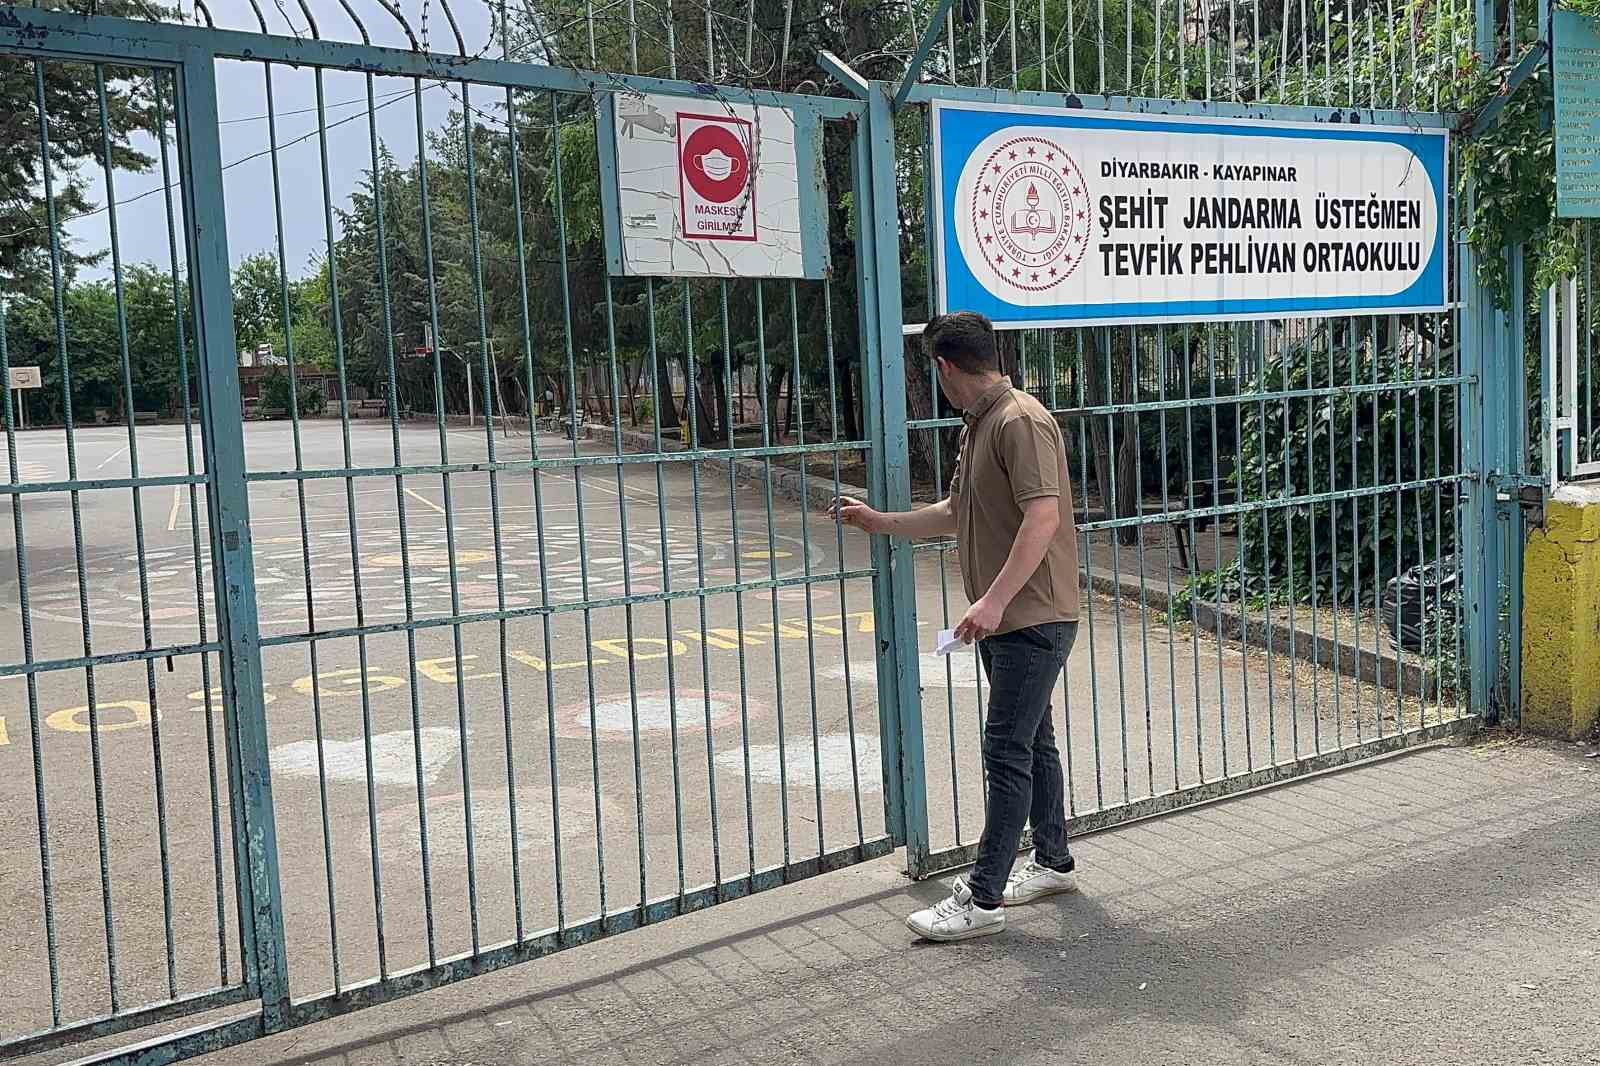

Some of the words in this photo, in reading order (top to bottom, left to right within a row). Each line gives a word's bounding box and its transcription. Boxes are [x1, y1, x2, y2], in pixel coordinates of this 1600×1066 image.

[1100, 157, 1200, 180] DİYARBAKIR
[1212, 164, 1297, 182] KAYAPINAR
[1099, 188, 1169, 238] ŞEHİT
[1183, 196, 1303, 230] JANDARMA
[1315, 192, 1421, 230] ÜSTEĞMEN
[1099, 235, 1184, 277] TEVFİK
[1190, 234, 1297, 275] PEHLİVAN
[1302, 241, 1421, 273] ORTAOKULU
